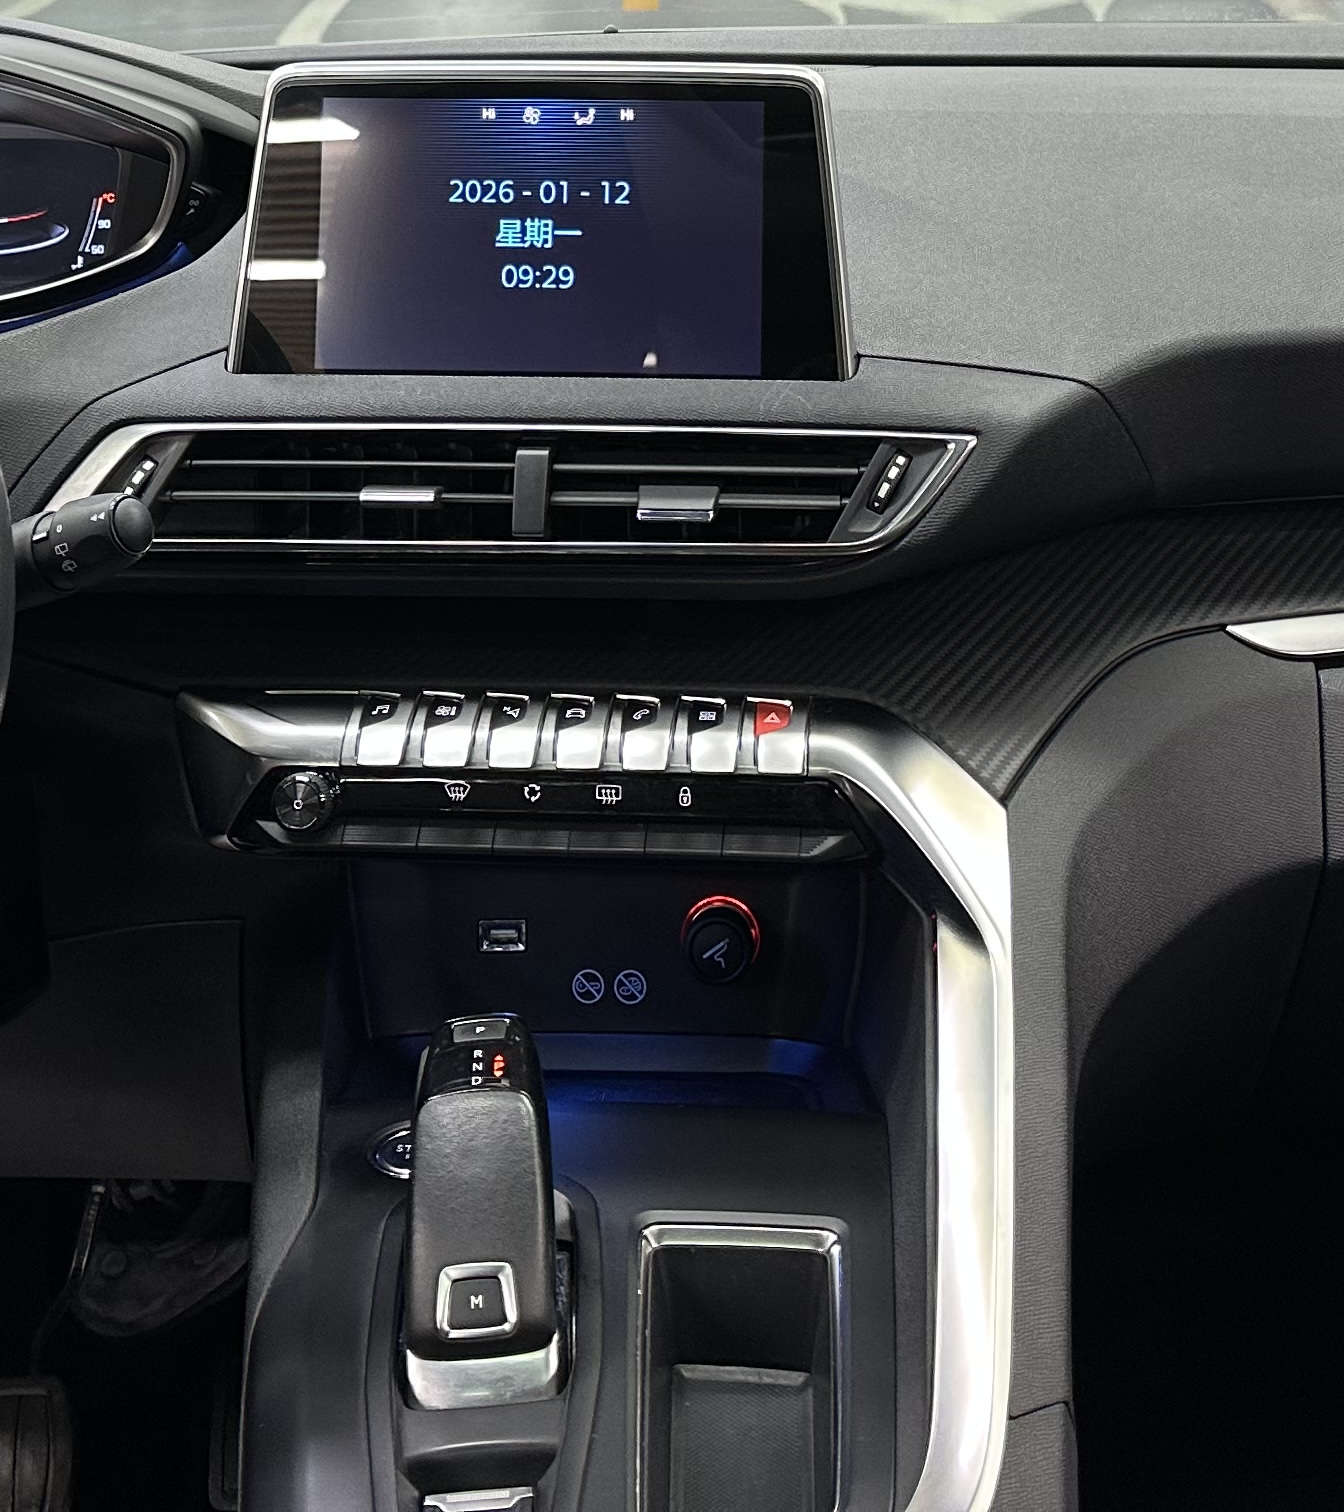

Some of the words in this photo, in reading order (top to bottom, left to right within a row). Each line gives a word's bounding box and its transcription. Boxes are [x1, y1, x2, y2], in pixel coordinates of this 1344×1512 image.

[449, 180, 514, 204] 2026
[539, 180, 568, 204] 01
[601, 181, 631, 205] 12
[495, 217, 583, 248] 星期一
[501, 265, 574, 289] 09:29
[475, 1026, 486, 1034] P
[473, 1049, 483, 1059] R
[472, 1062, 483, 1071] N
[471, 1076, 482, 1086] D
[470, 1294, 483, 1309] M
